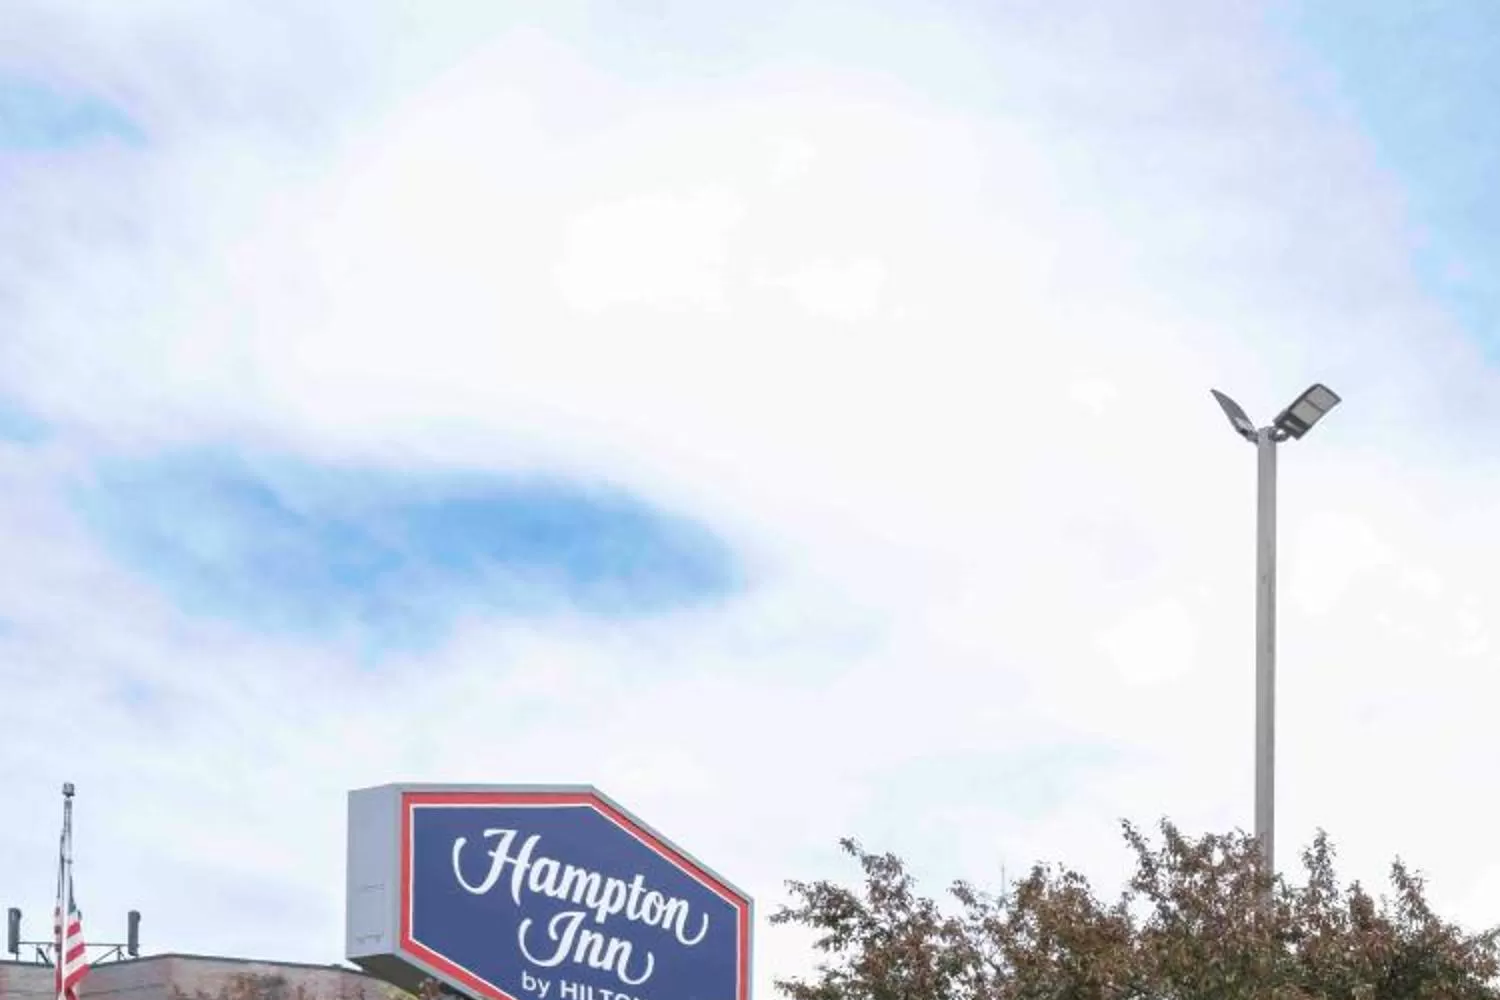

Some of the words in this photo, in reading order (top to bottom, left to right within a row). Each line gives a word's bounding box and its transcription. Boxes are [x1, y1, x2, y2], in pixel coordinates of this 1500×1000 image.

[452, 828, 709, 946] Hampton
[518, 911, 655, 985] Inn
[522, 970, 550, 999] by
